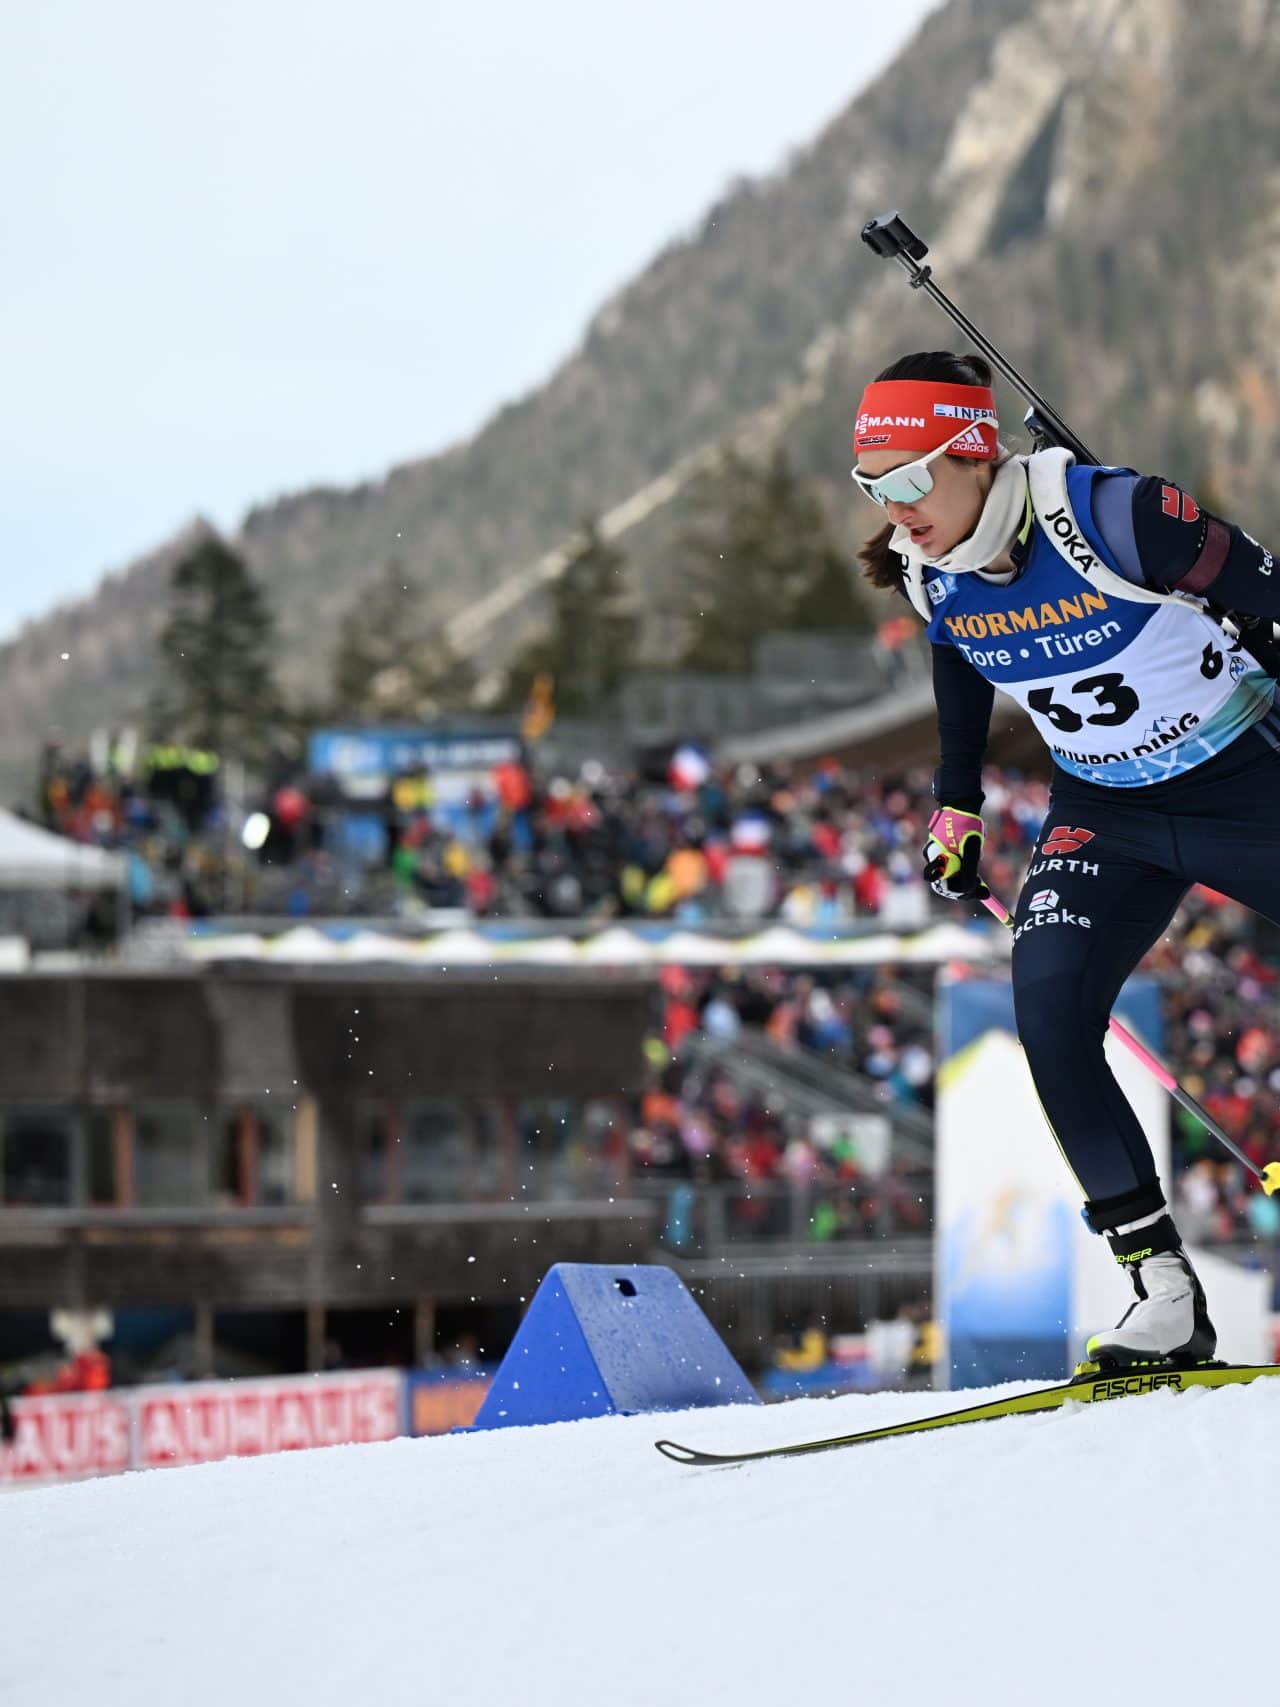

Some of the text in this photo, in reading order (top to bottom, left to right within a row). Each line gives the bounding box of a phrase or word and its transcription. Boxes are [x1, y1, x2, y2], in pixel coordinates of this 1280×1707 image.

[951, 441, 990, 453] adidas
[1044, 507, 1098, 575] JOKA
[944, 591, 1108, 639] HÖRMANN
[957, 620, 1122, 667] Tore Türen
[1027, 672, 1140, 733] 63
[1092, 1374, 1182, 1400] FISCHER
